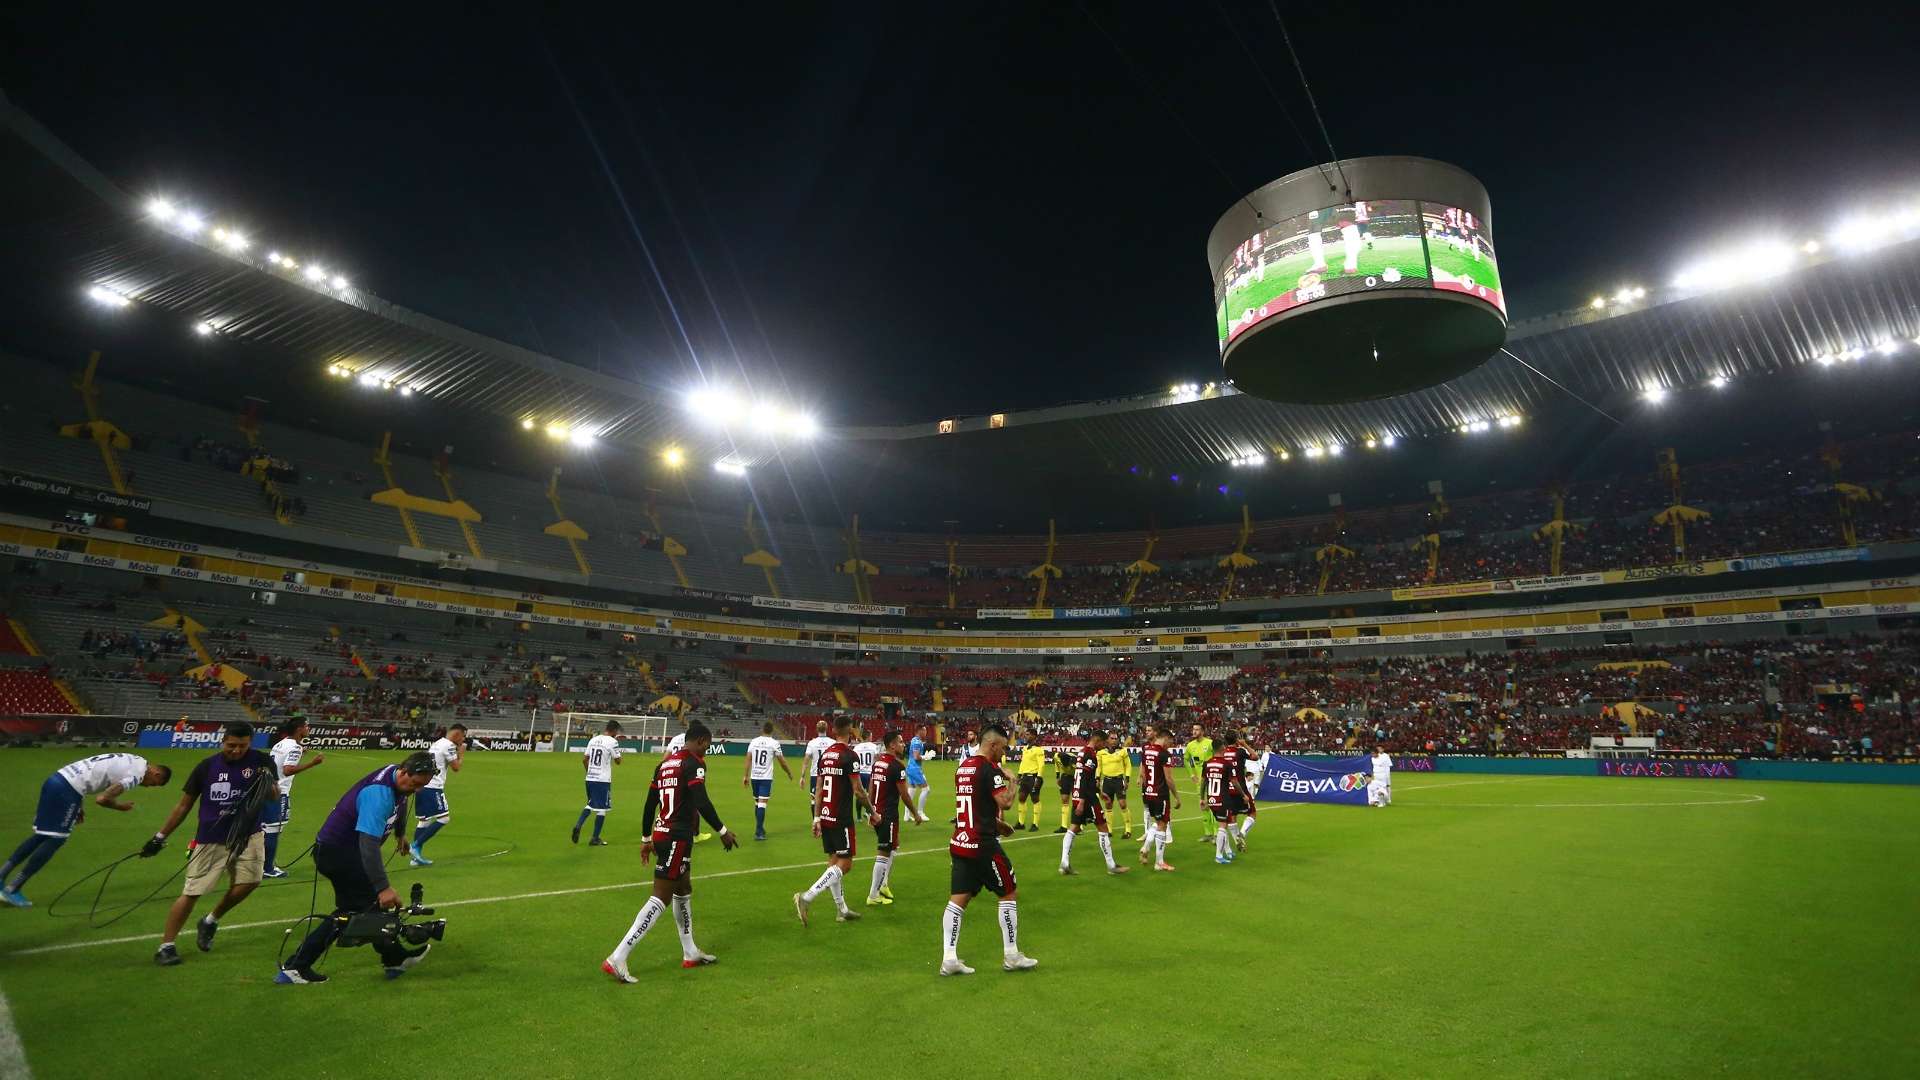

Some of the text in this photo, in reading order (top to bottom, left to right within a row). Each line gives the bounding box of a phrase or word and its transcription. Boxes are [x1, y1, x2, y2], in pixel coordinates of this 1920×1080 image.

[51, 522, 91, 535] PVC
[34, 549, 69, 561] Mobil
[83, 555, 115, 567] Mobil
[128, 561, 158, 573] Mobil
[171, 567, 199, 578] Mobil
[211, 573, 238, 583] Mobil
[250, 579, 275, 588] Mobil
[285, 583, 310, 593] Mobil
[320, 588, 344, 597] Mobil
[353, 593, 376, 601] Mobil
[385, 597, 407, 605] Mobil
[416, 601, 437, 609] Mobil
[475, 608, 495, 616] Mobil
[503, 611, 523, 619] Mobil
[1065, 608, 1120, 617] HERRALUM
[300, 737, 367, 746] camcar
[590, 748, 603, 767] 18
[754, 749, 768, 766] 16
[1268, 768, 1299, 780] LIGA
[822, 775, 833, 803] 9
[1207, 778, 1221, 797] 10
[1280, 777, 1338, 794] BBVA
[956, 795, 974, 829] 21
[627, 905, 658, 946] PERDURA
